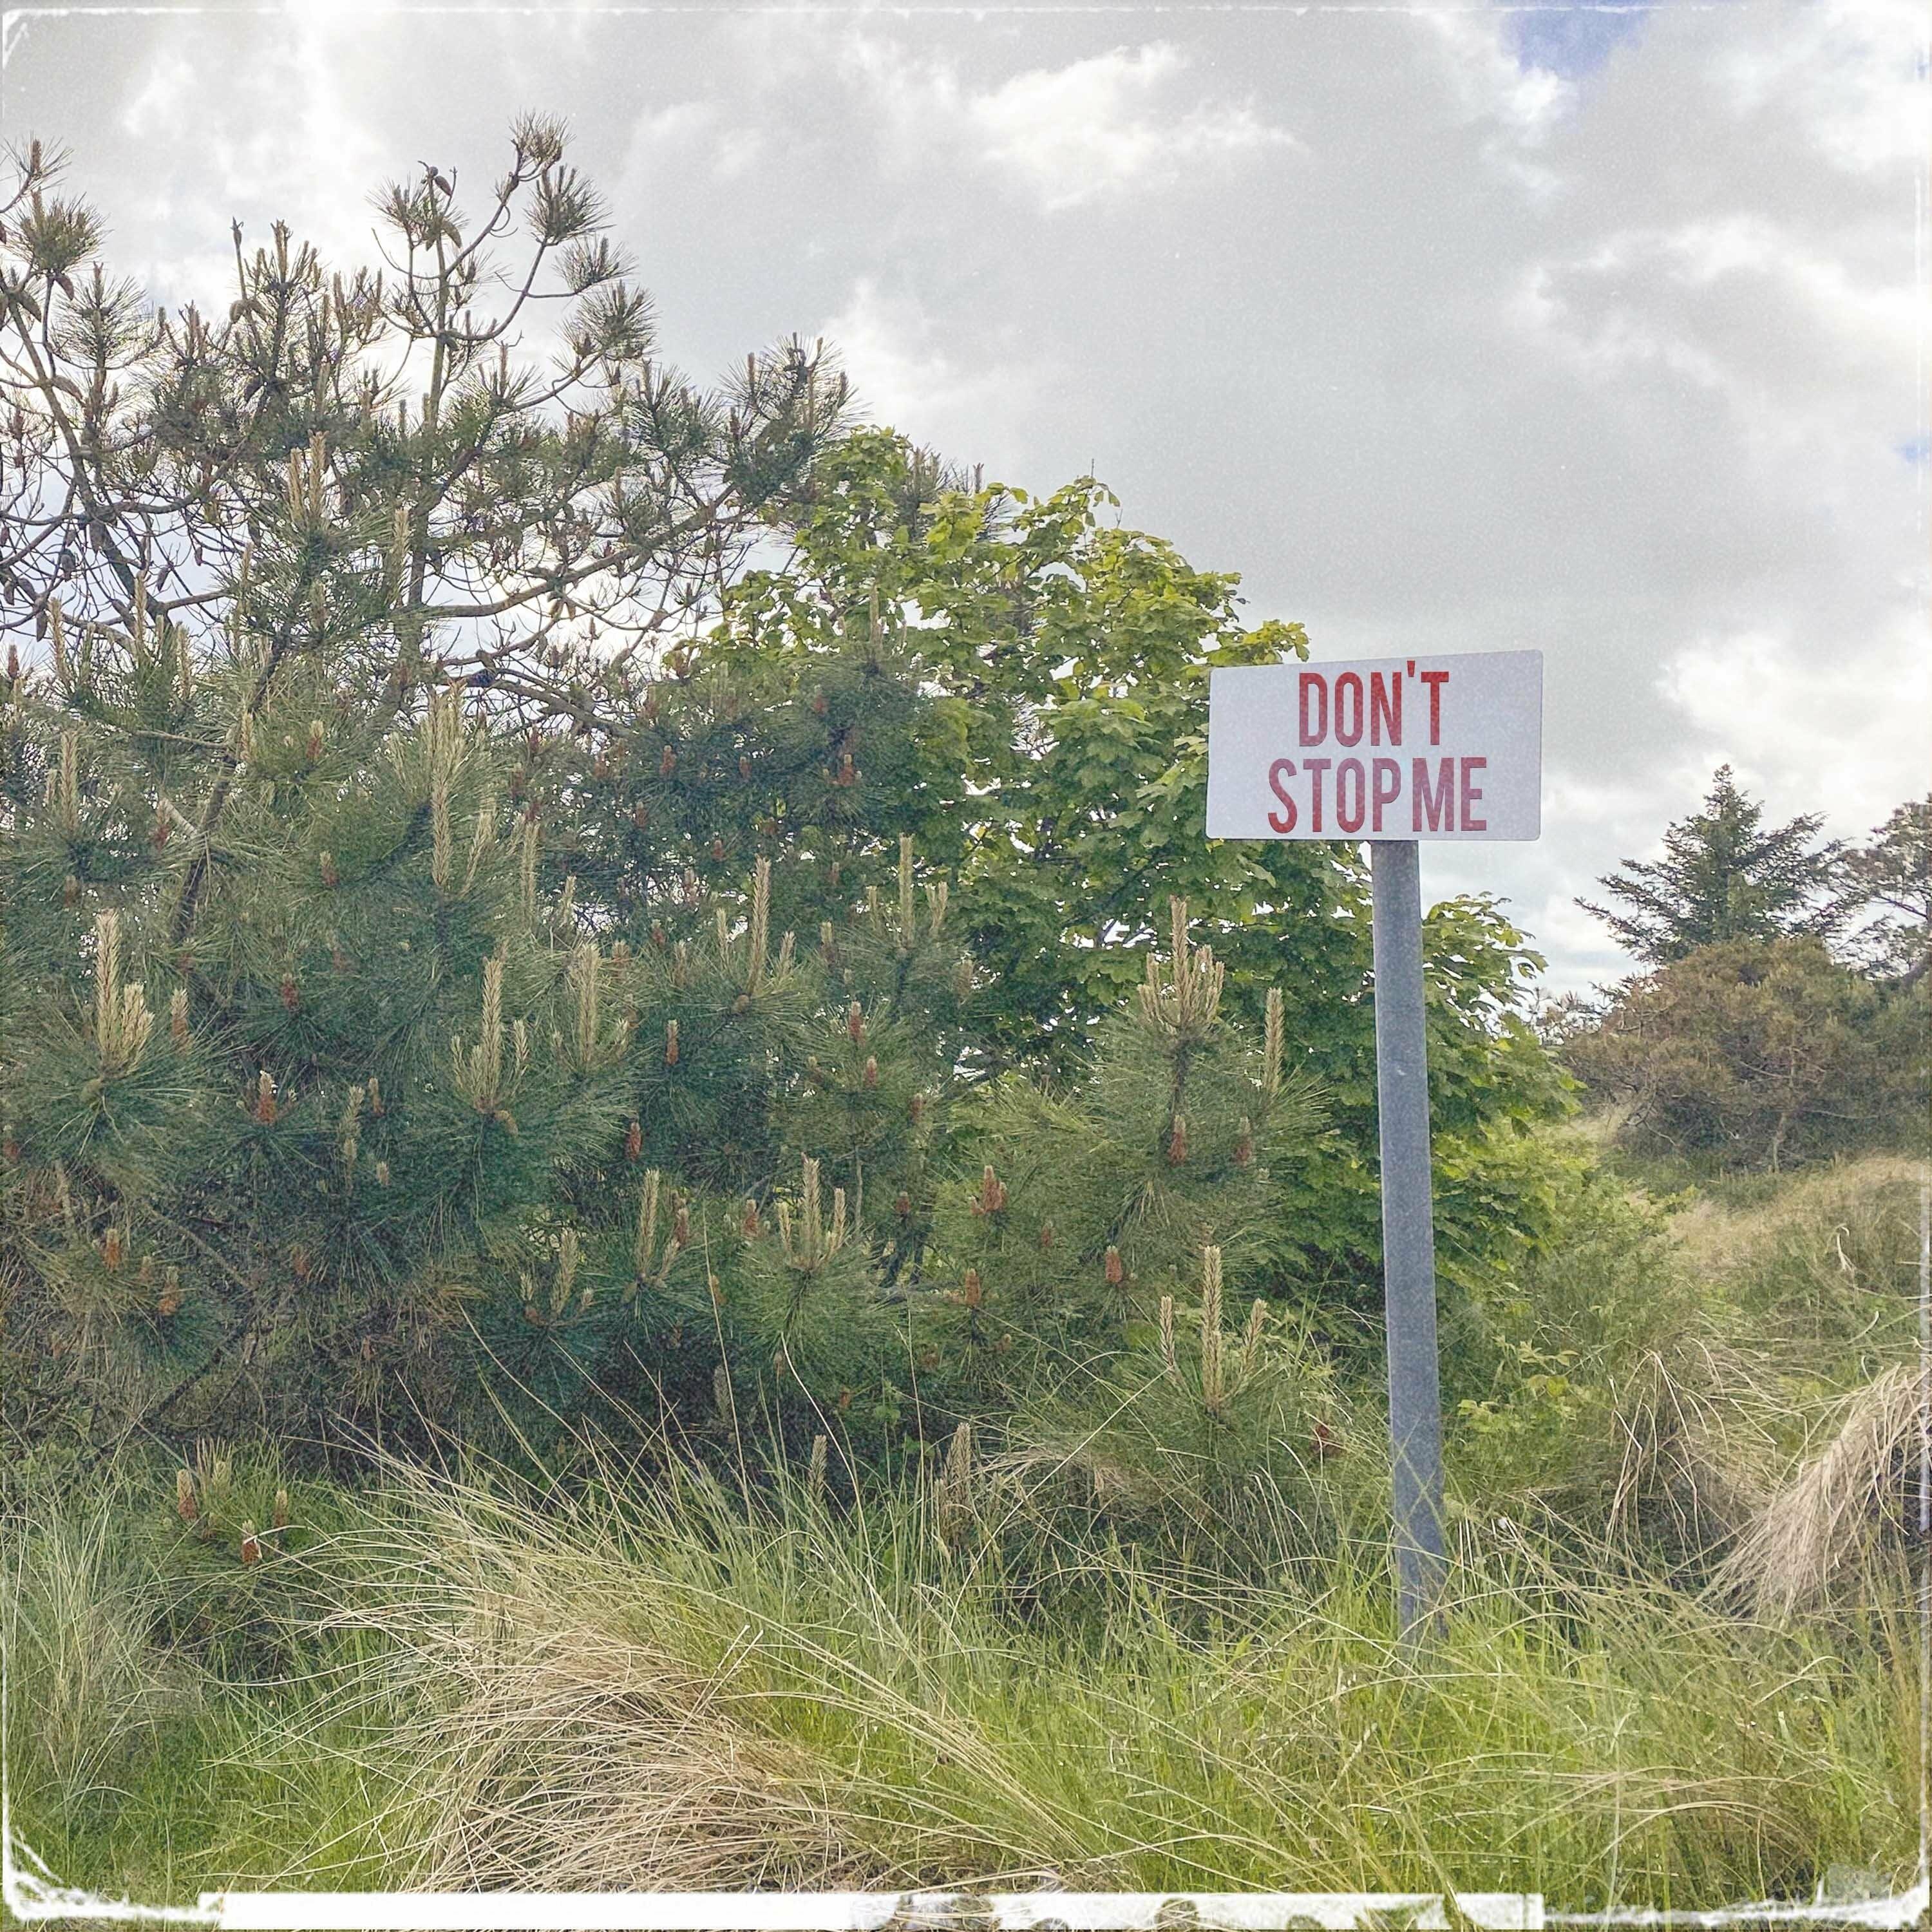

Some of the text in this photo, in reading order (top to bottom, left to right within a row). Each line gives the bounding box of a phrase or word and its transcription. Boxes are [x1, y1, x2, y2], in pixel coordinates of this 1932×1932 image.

[1299, 660, 1450, 747] DON'T
[1267, 757, 1487, 833] STOP ME
